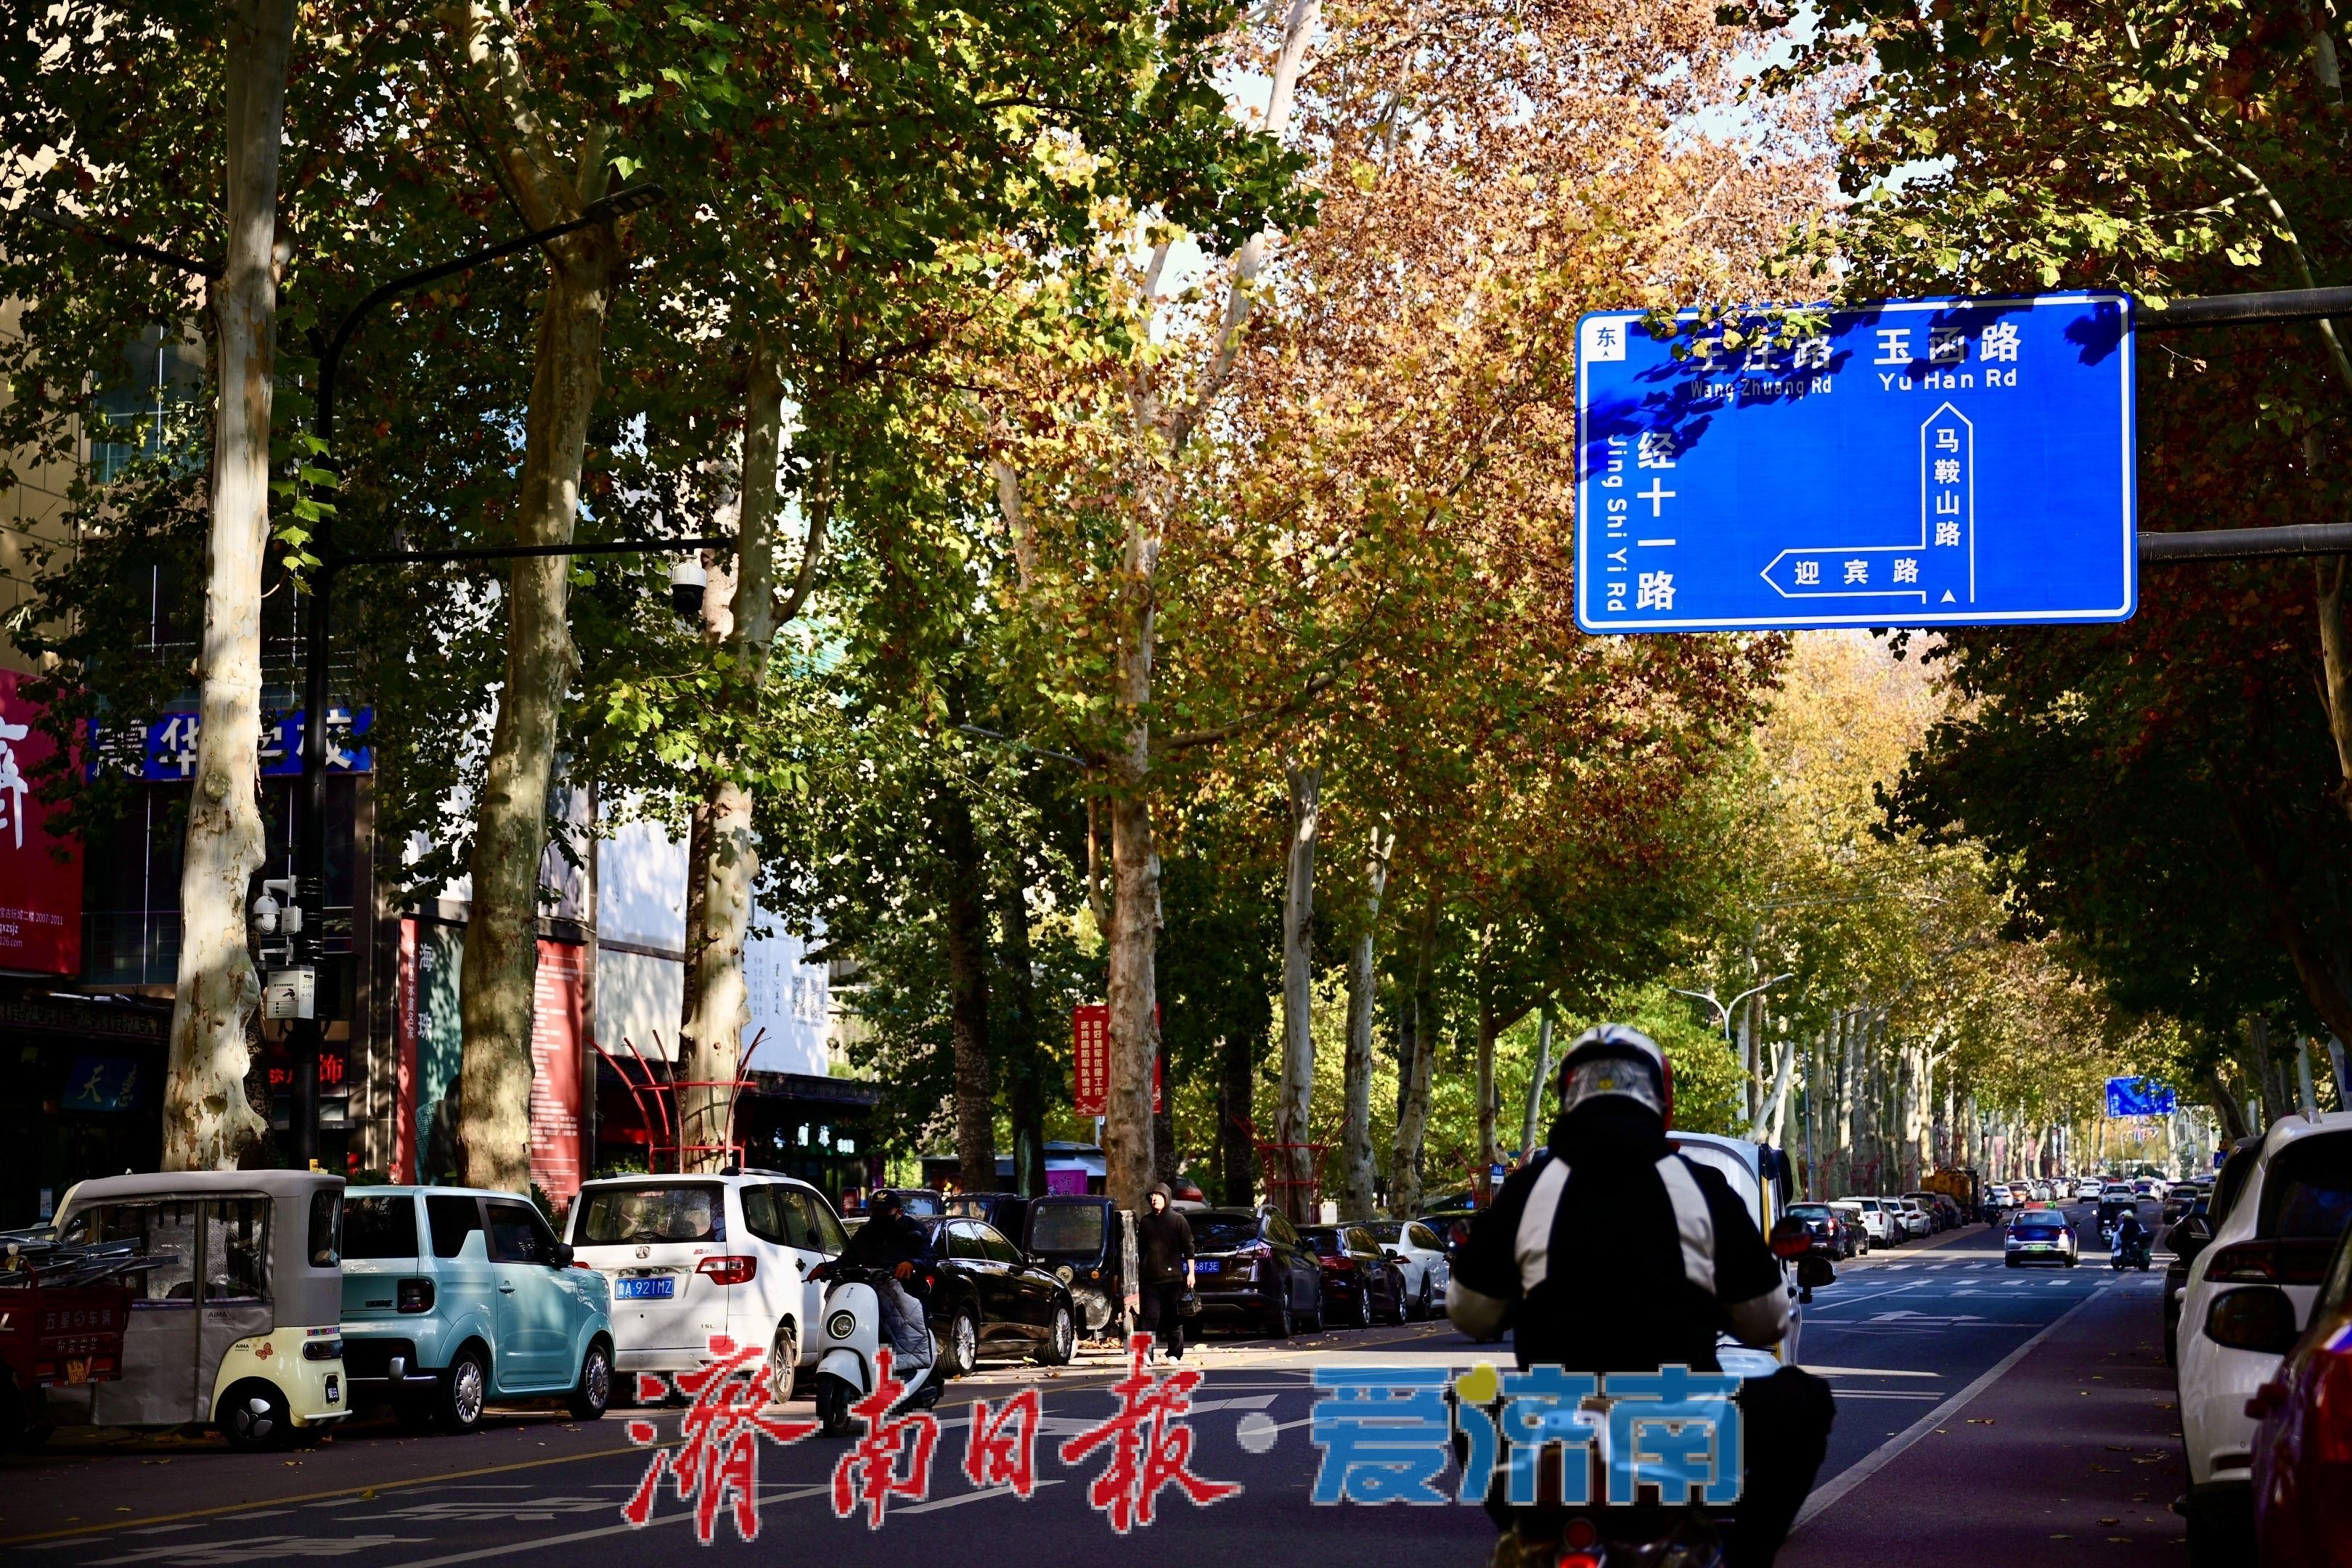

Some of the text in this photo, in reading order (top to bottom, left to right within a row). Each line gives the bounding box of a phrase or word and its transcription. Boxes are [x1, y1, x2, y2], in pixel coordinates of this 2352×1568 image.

[1597, 327, 1616, 347] 东
[1690, 332, 1834, 372] 王庄路
[1874, 322, 2022, 365] 玉函路
[1691, 375, 1832, 403] Wang Zhuang Rd
[1877, 367, 2017, 391] Yu Han Rd
[1934, 428, 1961, 547] 马鞍山路
[1601, 434, 1628, 612] Jing Shi Yi Rd
[1636, 431, 1677, 611] 经十一路
[1794, 558, 1919, 585] 迎宾路
